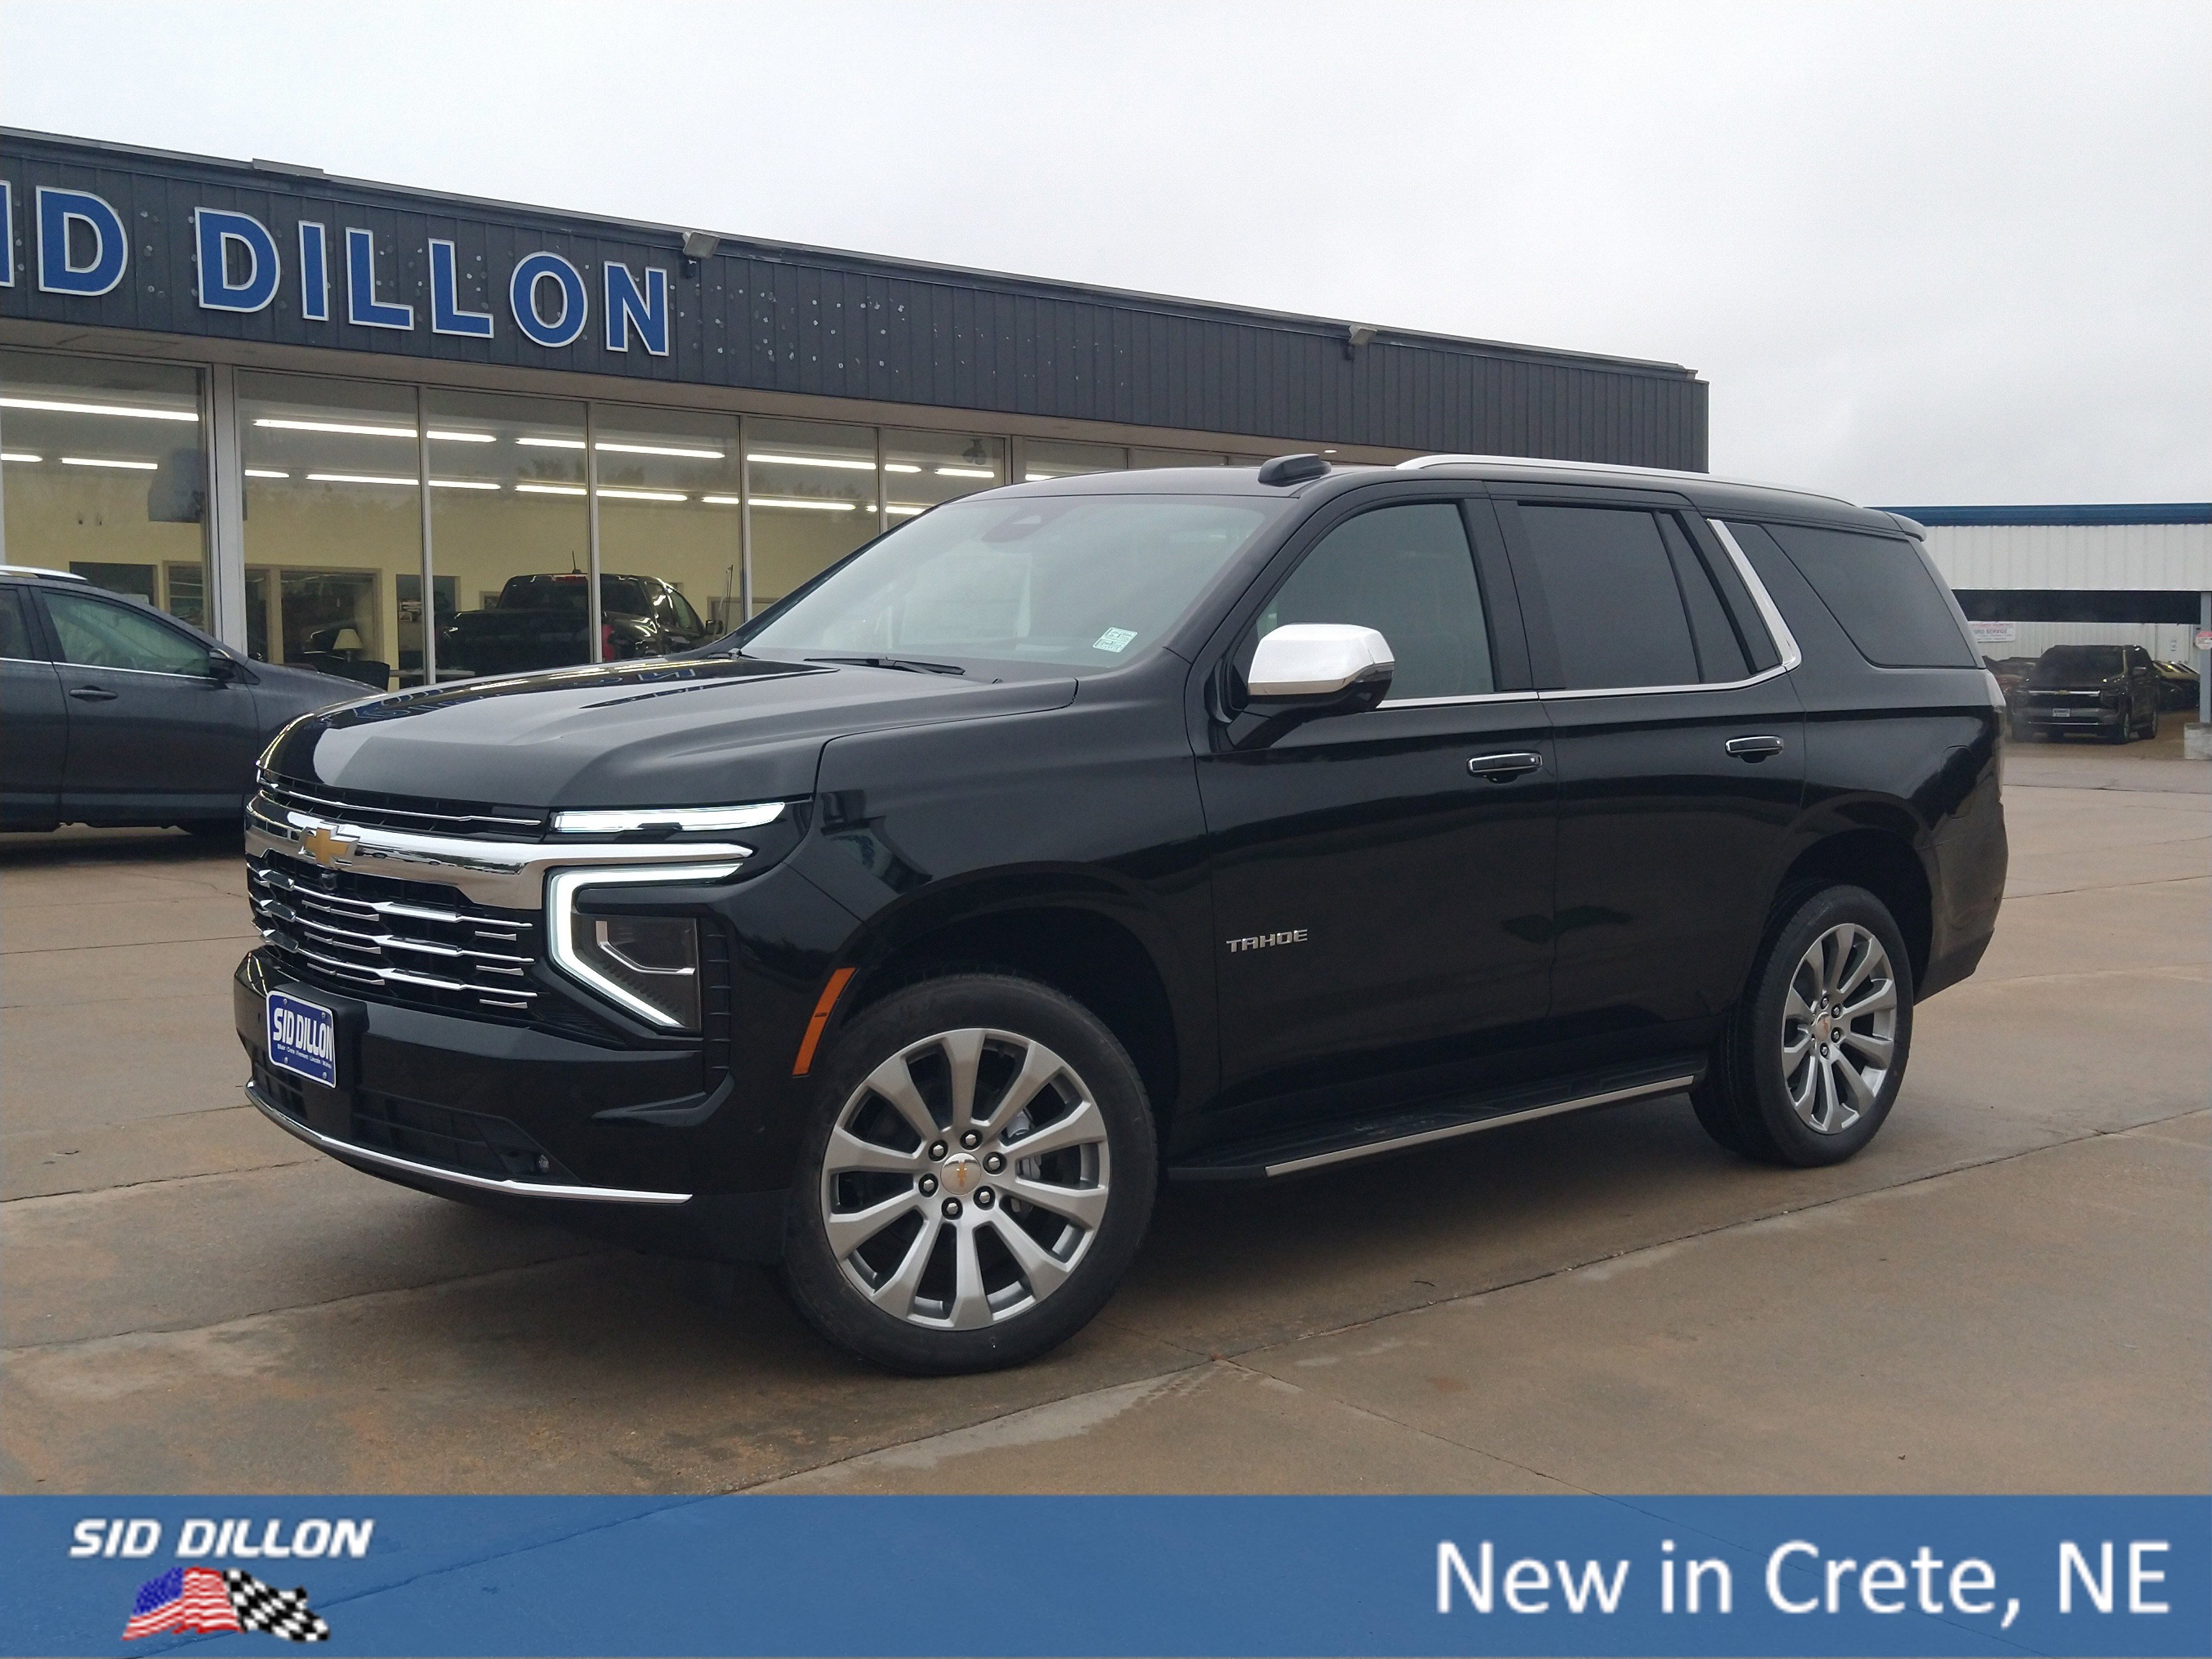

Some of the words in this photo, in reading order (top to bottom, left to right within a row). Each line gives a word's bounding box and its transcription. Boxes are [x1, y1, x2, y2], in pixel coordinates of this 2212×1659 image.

[194, 207, 670, 357] DILLON
[1226, 928, 1308, 953] TAHOE
[273, 1008, 295, 1045] SID
[295, 1014, 332, 1062] DILLON
